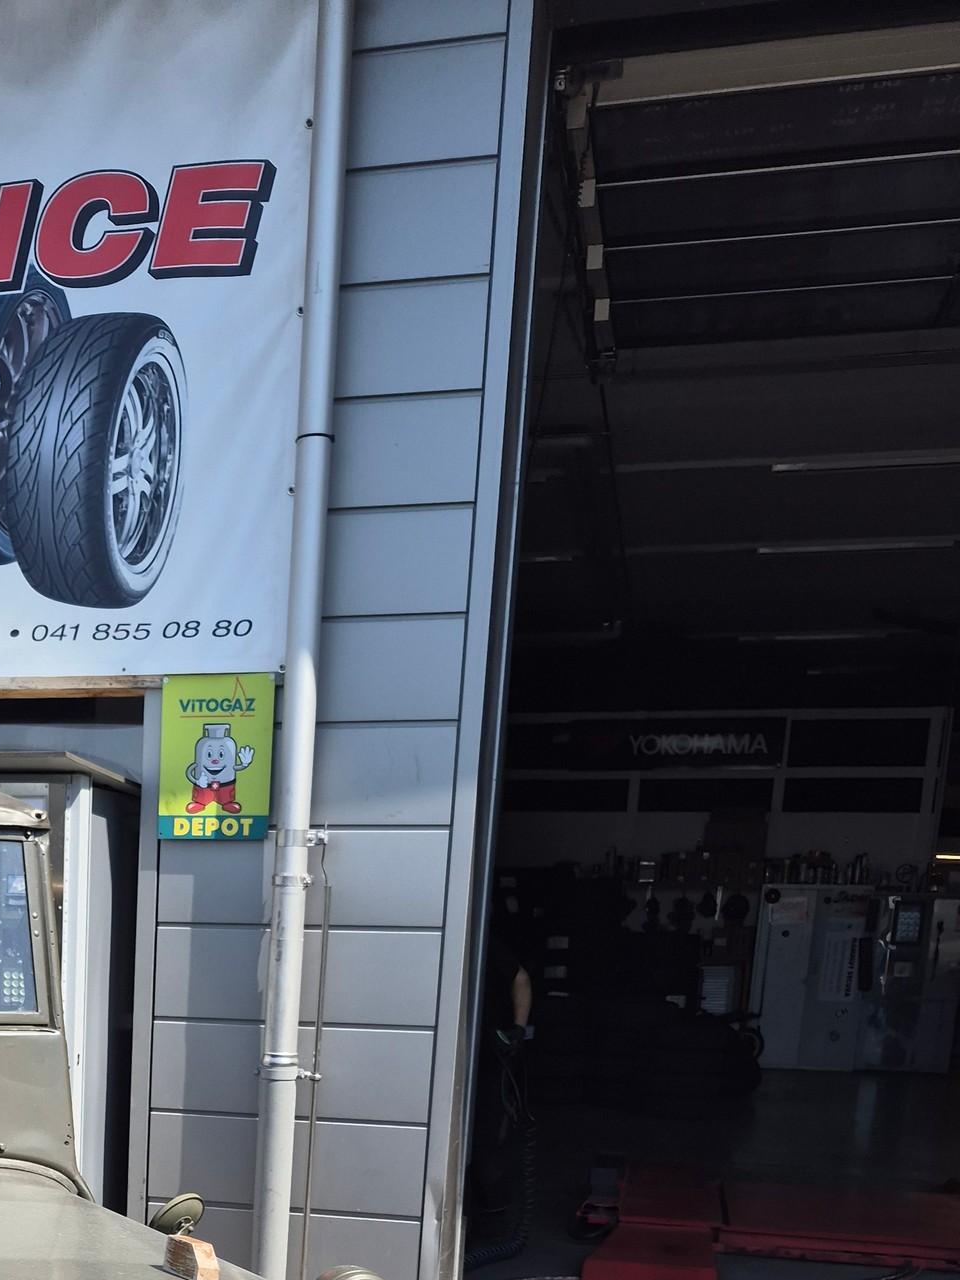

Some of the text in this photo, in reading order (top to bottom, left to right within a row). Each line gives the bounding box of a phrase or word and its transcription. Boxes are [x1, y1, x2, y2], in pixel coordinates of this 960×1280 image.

[31, 623, 81, 642] 041
[91, 622, 152, 641] 855
[162, 619, 201, 639] 08
[211, 618, 253, 638] 80
[628, 733, 769, 757] YOKOHAMA
[173, 817, 253, 837] DEPOT
